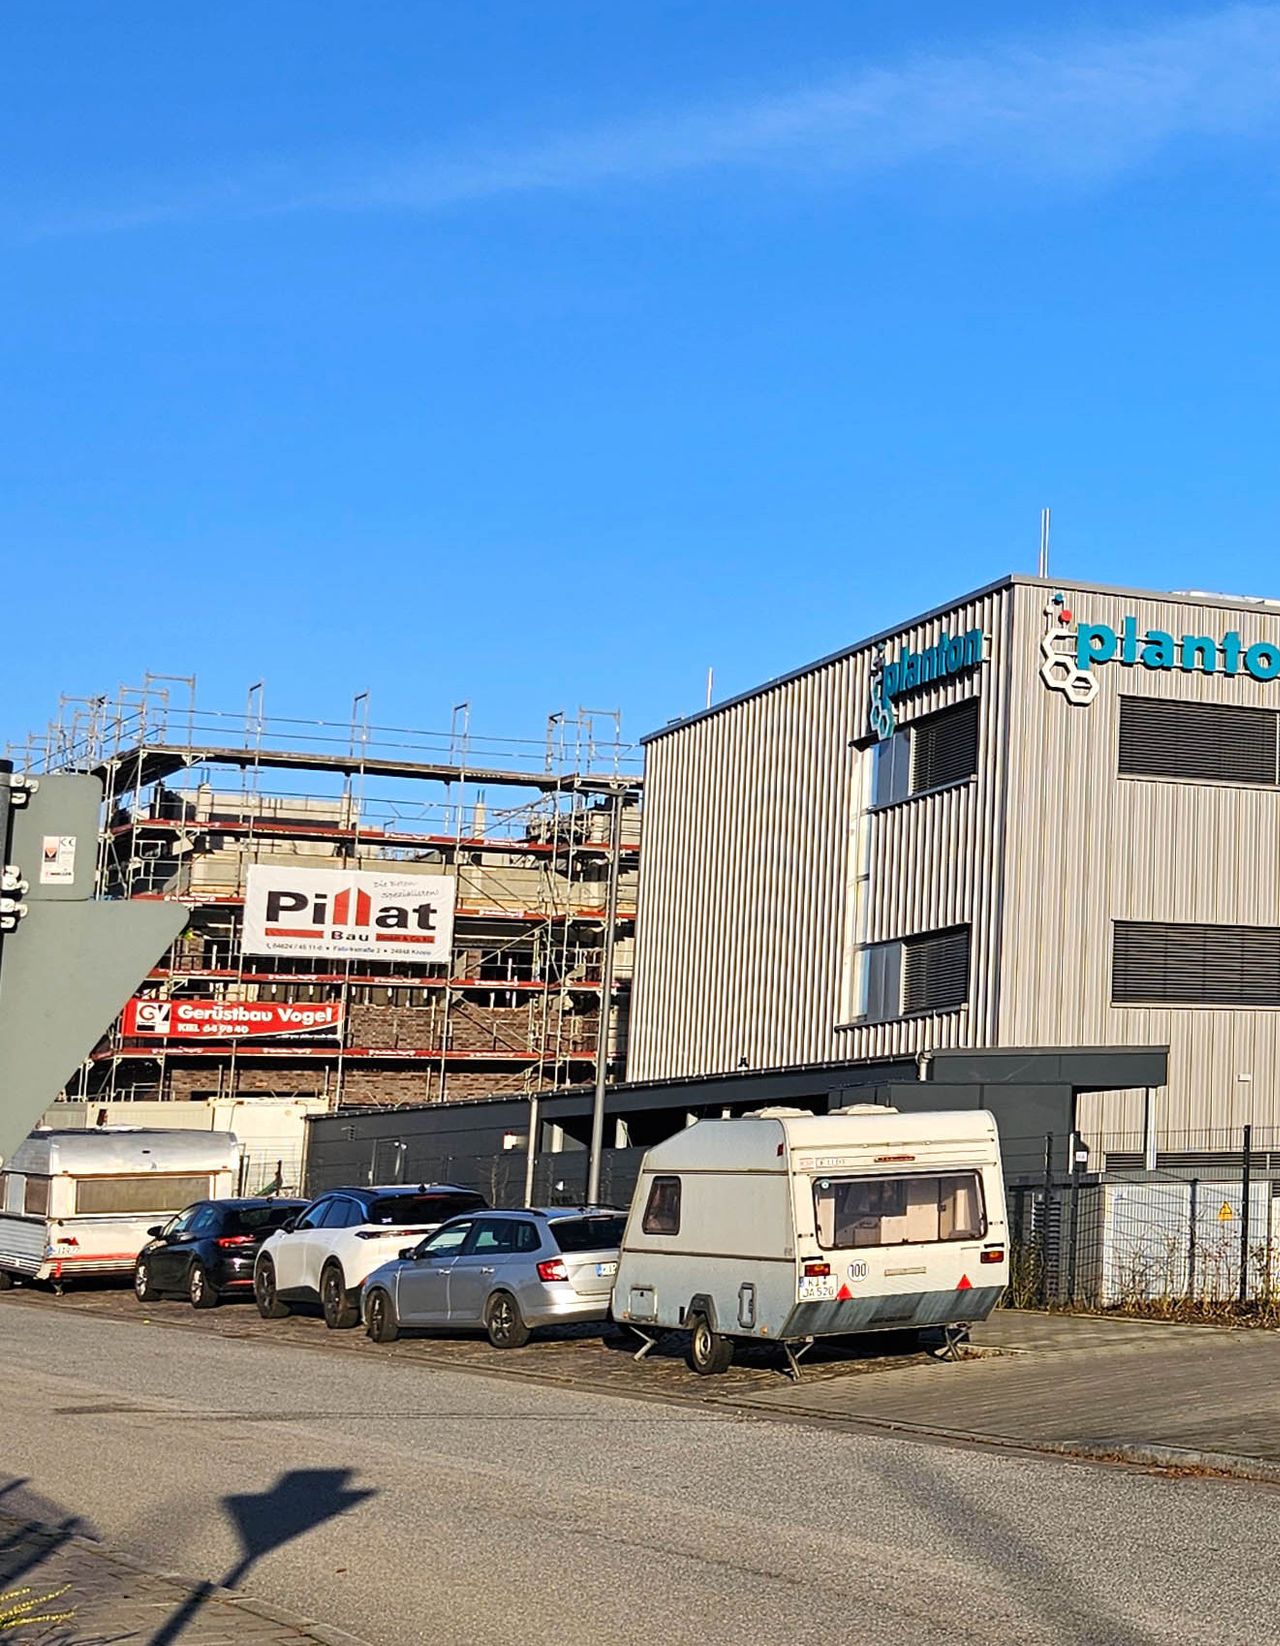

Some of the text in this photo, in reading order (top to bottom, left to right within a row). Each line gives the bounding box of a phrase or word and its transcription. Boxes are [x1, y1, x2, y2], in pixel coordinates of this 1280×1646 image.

[883, 628, 982, 699] planton
[265, 887, 438, 931] Pillat
[331, 930, 369, 942] Bau
[177, 1004, 333, 1025] Gerüstbau Vogel
[177, 1023, 200, 1033] KIEL
[234, 1025, 249, 1034] 40
[850, 1263, 867, 1277] 100
